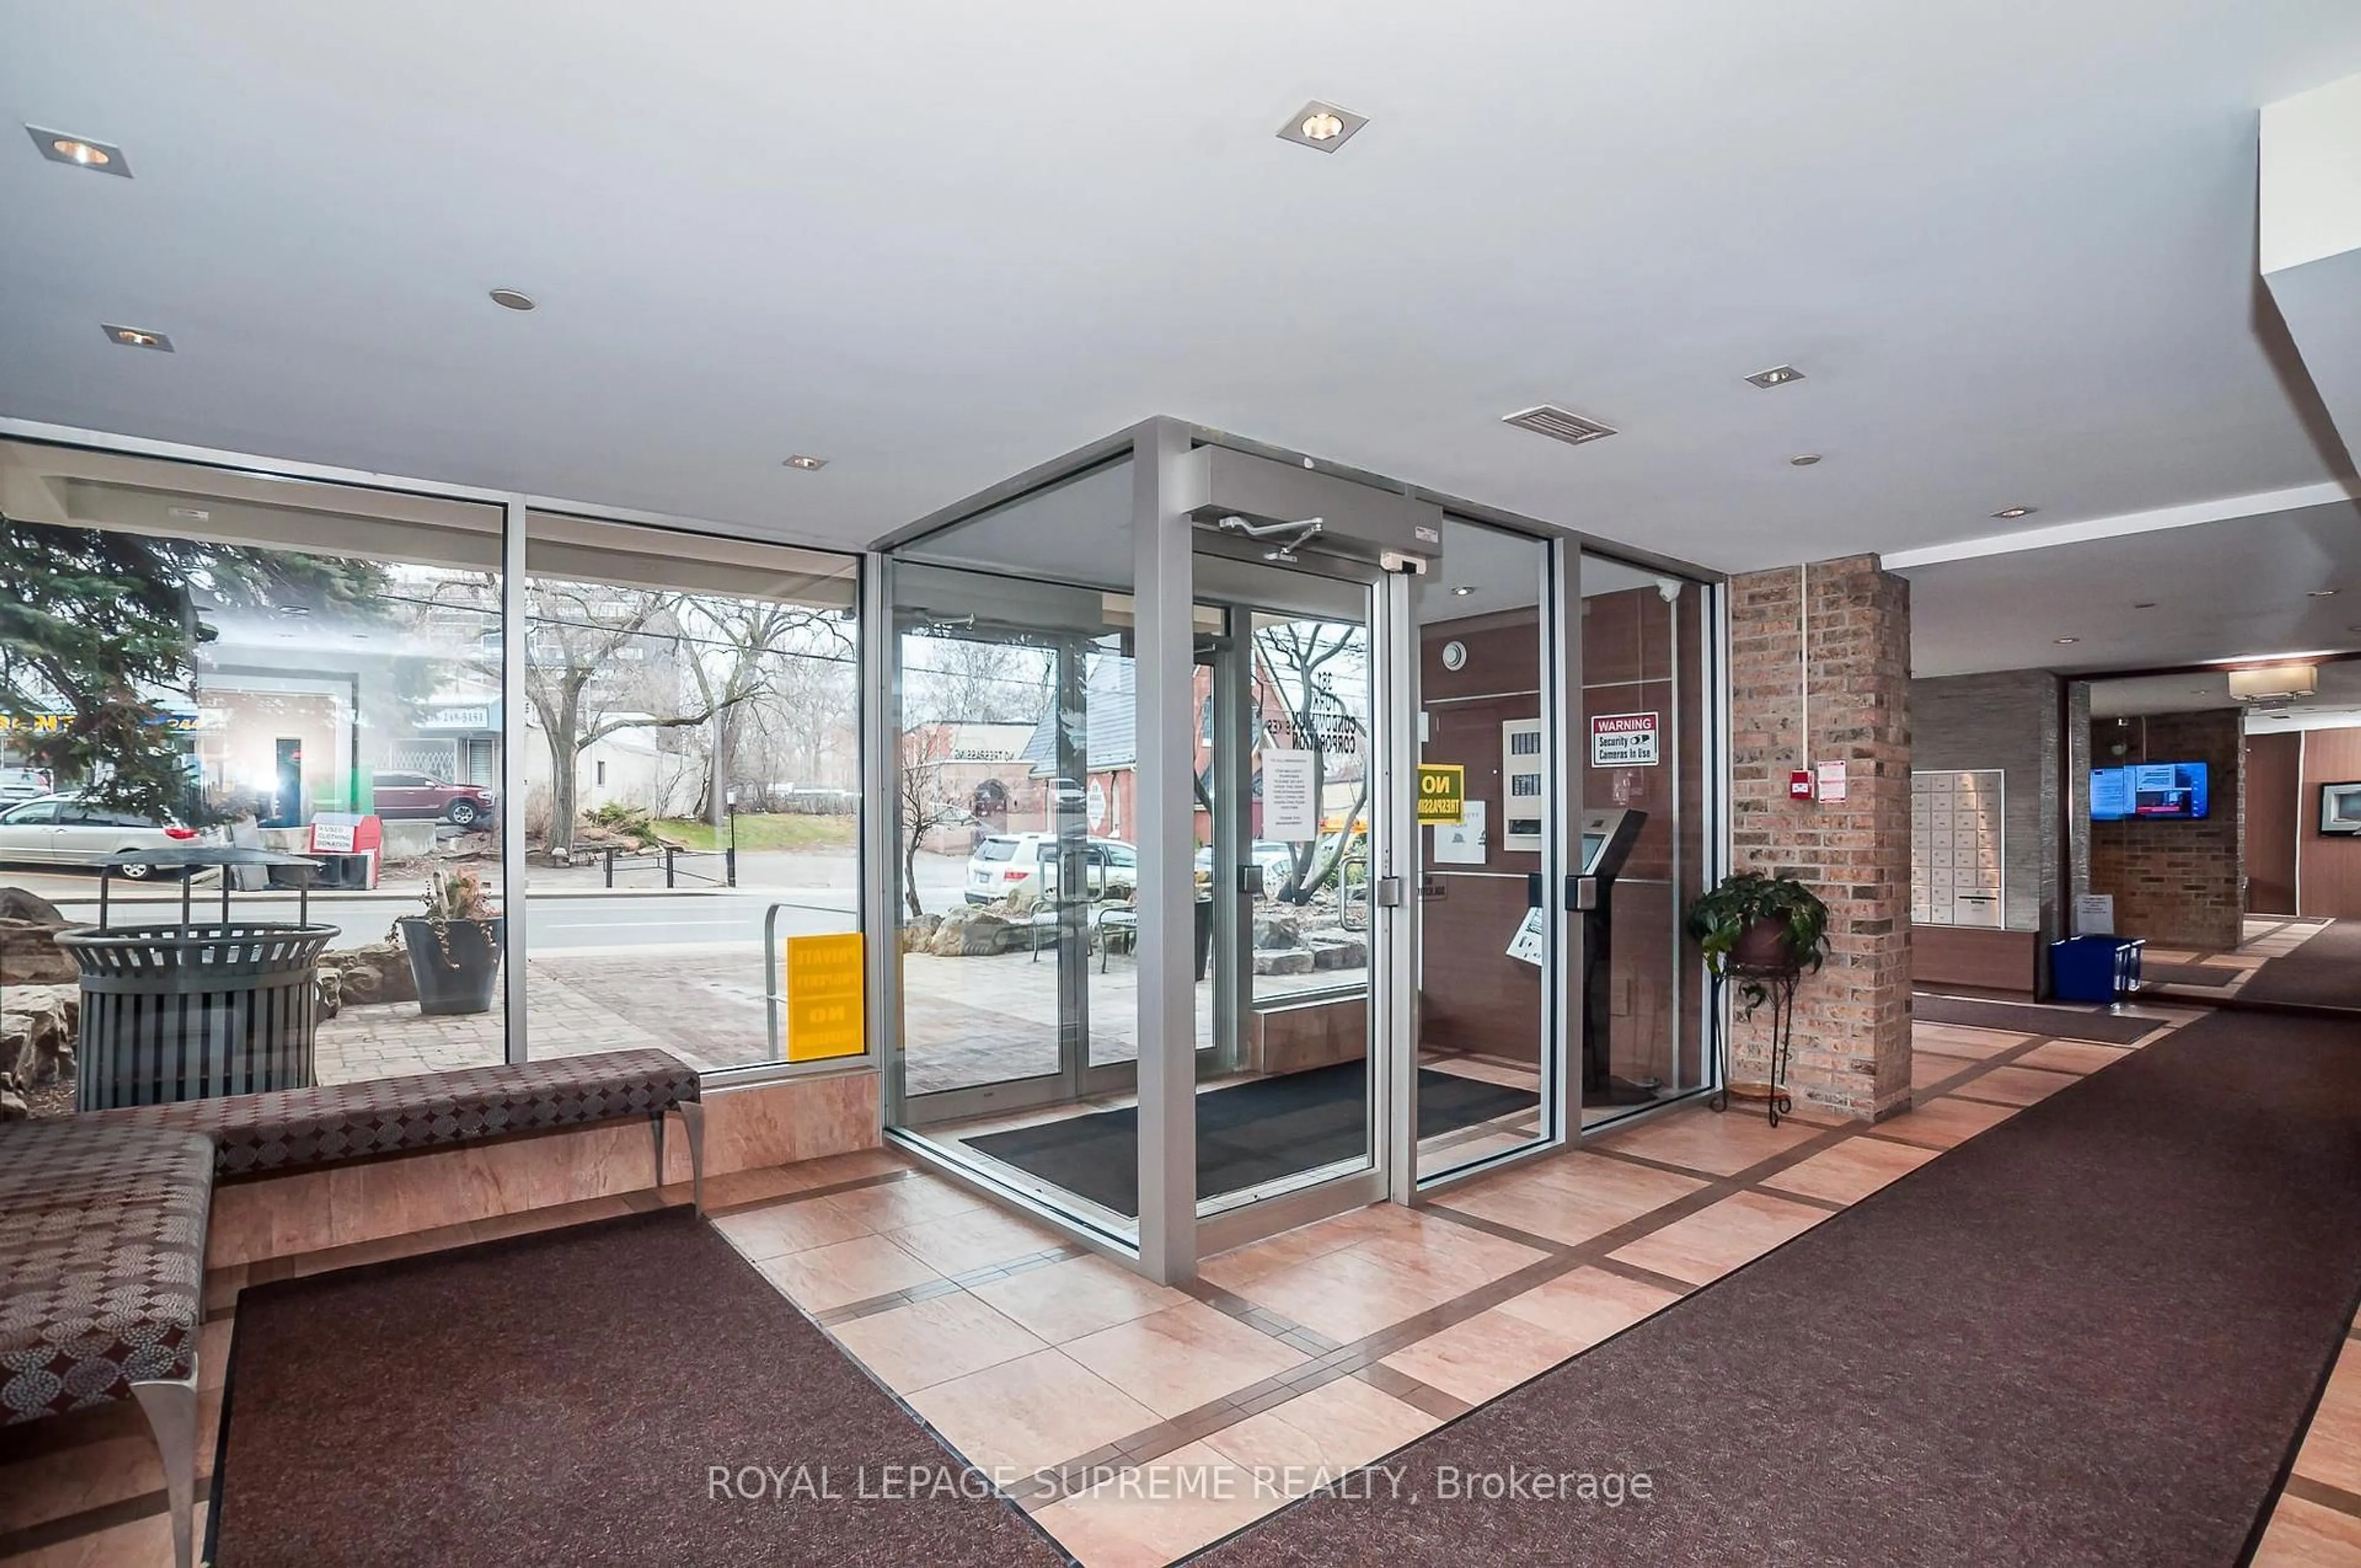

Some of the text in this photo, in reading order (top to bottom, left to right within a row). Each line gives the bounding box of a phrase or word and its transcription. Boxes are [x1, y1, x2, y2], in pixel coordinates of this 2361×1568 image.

[1599, 718, 1651, 732] WARNING
[1600, 736, 1628, 748] Security
[1600, 750, 1627, 759] Cameras
[1638, 748, 1650, 758] Use
